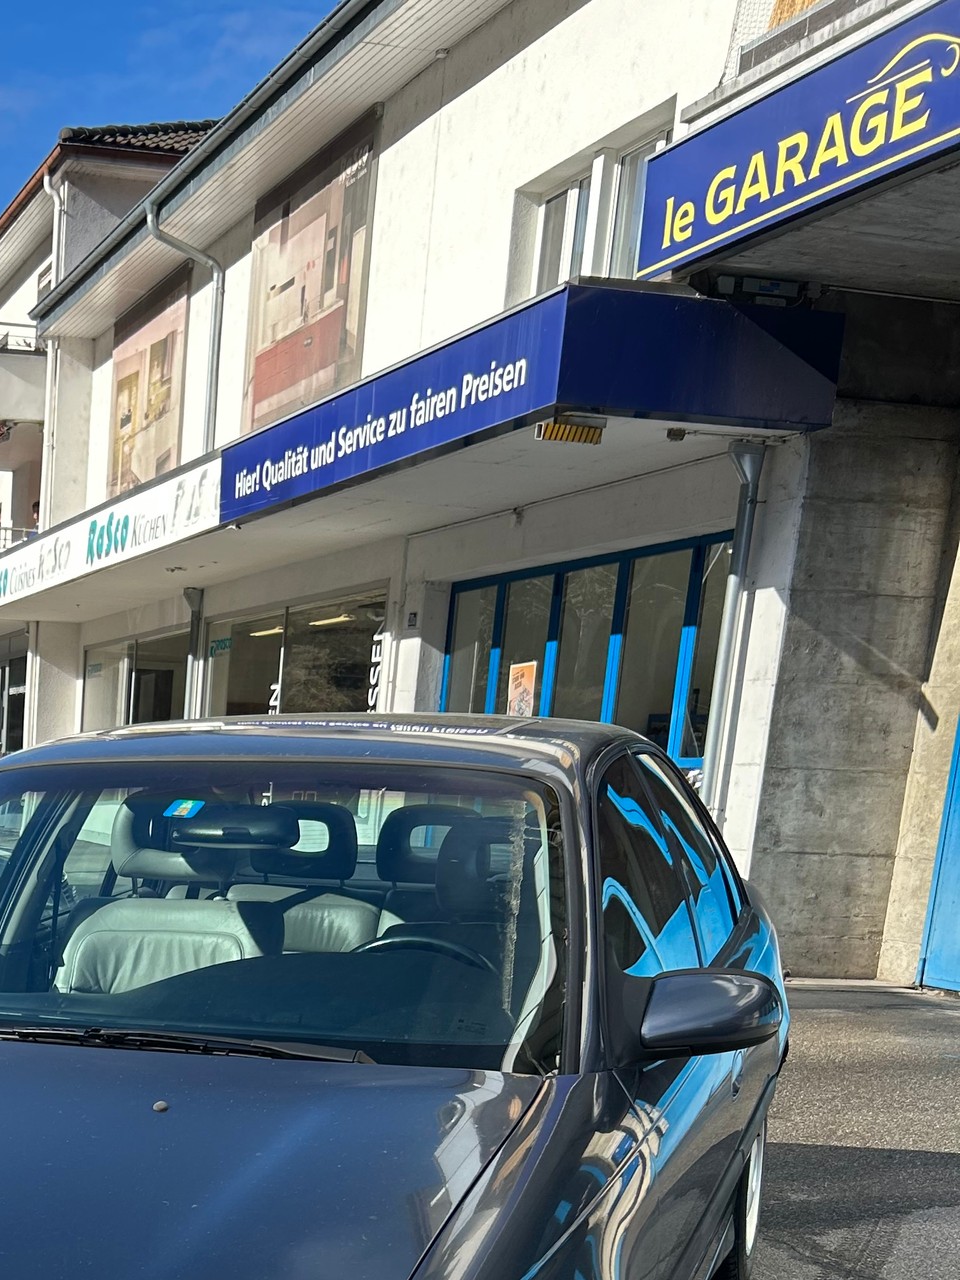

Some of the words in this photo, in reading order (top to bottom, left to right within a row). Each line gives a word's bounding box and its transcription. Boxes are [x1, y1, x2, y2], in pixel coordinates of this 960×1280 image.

[661, 196, 695, 249] le
[705, 67, 933, 226] GARAGE
[235, 458, 260, 499] Hier!
[262, 446, 309, 491] Qualität
[310, 431, 336, 468] und
[338, 414, 385, 458] Service
[387, 408, 406, 438] zu
[410, 387, 457, 429] fairen
[461, 358, 527, 409] Preisen
